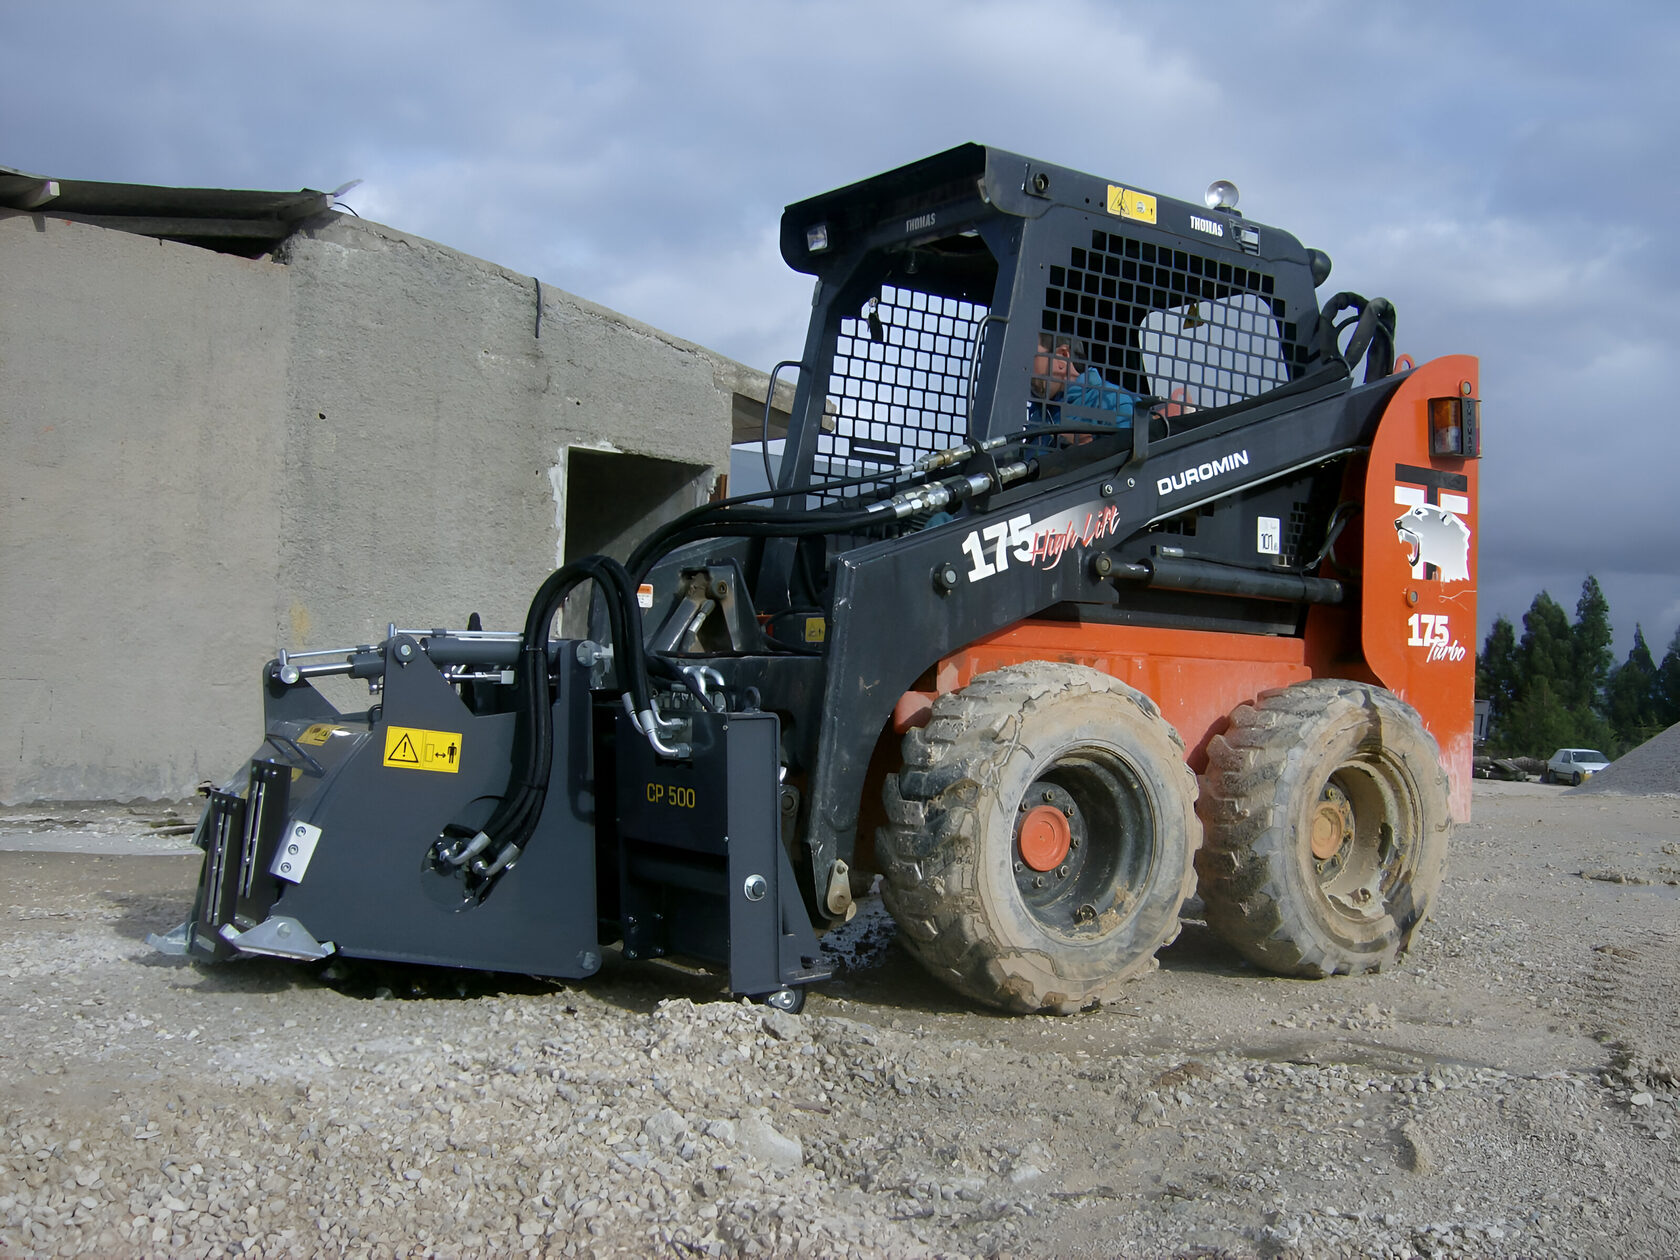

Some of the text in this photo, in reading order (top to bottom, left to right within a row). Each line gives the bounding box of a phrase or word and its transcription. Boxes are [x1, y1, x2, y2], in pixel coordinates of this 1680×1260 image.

[1190, 216, 1224, 238] THOMAS
[1157, 450, 1249, 496] DUROMIN
[961, 504, 1121, 583] 175 High Lift
[1408, 613, 1450, 648] 175
[1426, 636, 1466, 663] Turbo
[646, 782, 696, 809] CP 500
